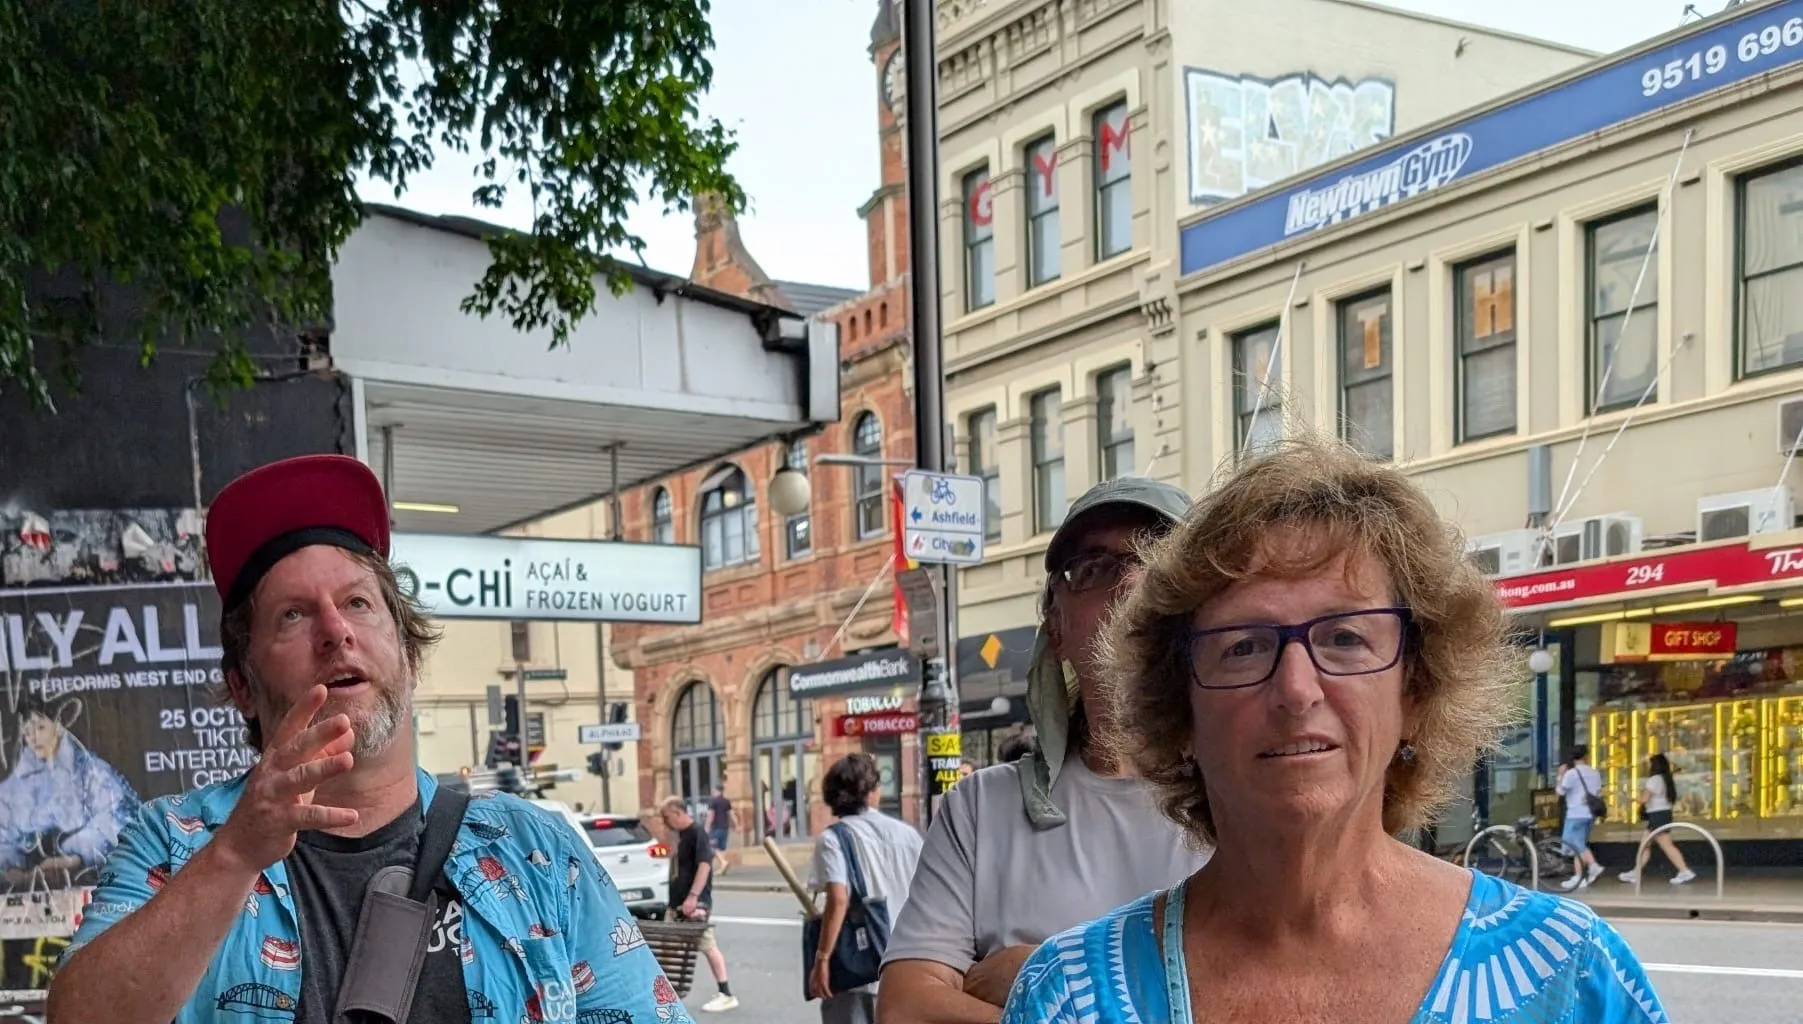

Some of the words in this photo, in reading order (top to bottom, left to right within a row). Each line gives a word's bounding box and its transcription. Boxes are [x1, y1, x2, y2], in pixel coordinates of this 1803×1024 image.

[1641, 45, 1727, 97] 9519
[1737, 17, 1803, 62] 696
[1286, 164, 1402, 232] Newtown
[932, 511, 976, 525] Ashfield
[577, 564, 588, 582] &
[1625, 563, 1664, 586] 294
[526, 590, 603, 611] FROZEN
[610, 591, 688, 612] YOGURT
[98, 603, 223, 665] ALL
[1664, 630, 1689, 646] GIFT
[1692, 630, 1722, 646] SHOP
[125, 670, 168, 688] WEST
[172, 668, 206, 685] END
[846, 695, 903, 715] TOBACCO
[160, 709, 186, 729] 25
[862, 718, 916, 732] TOBACCO
